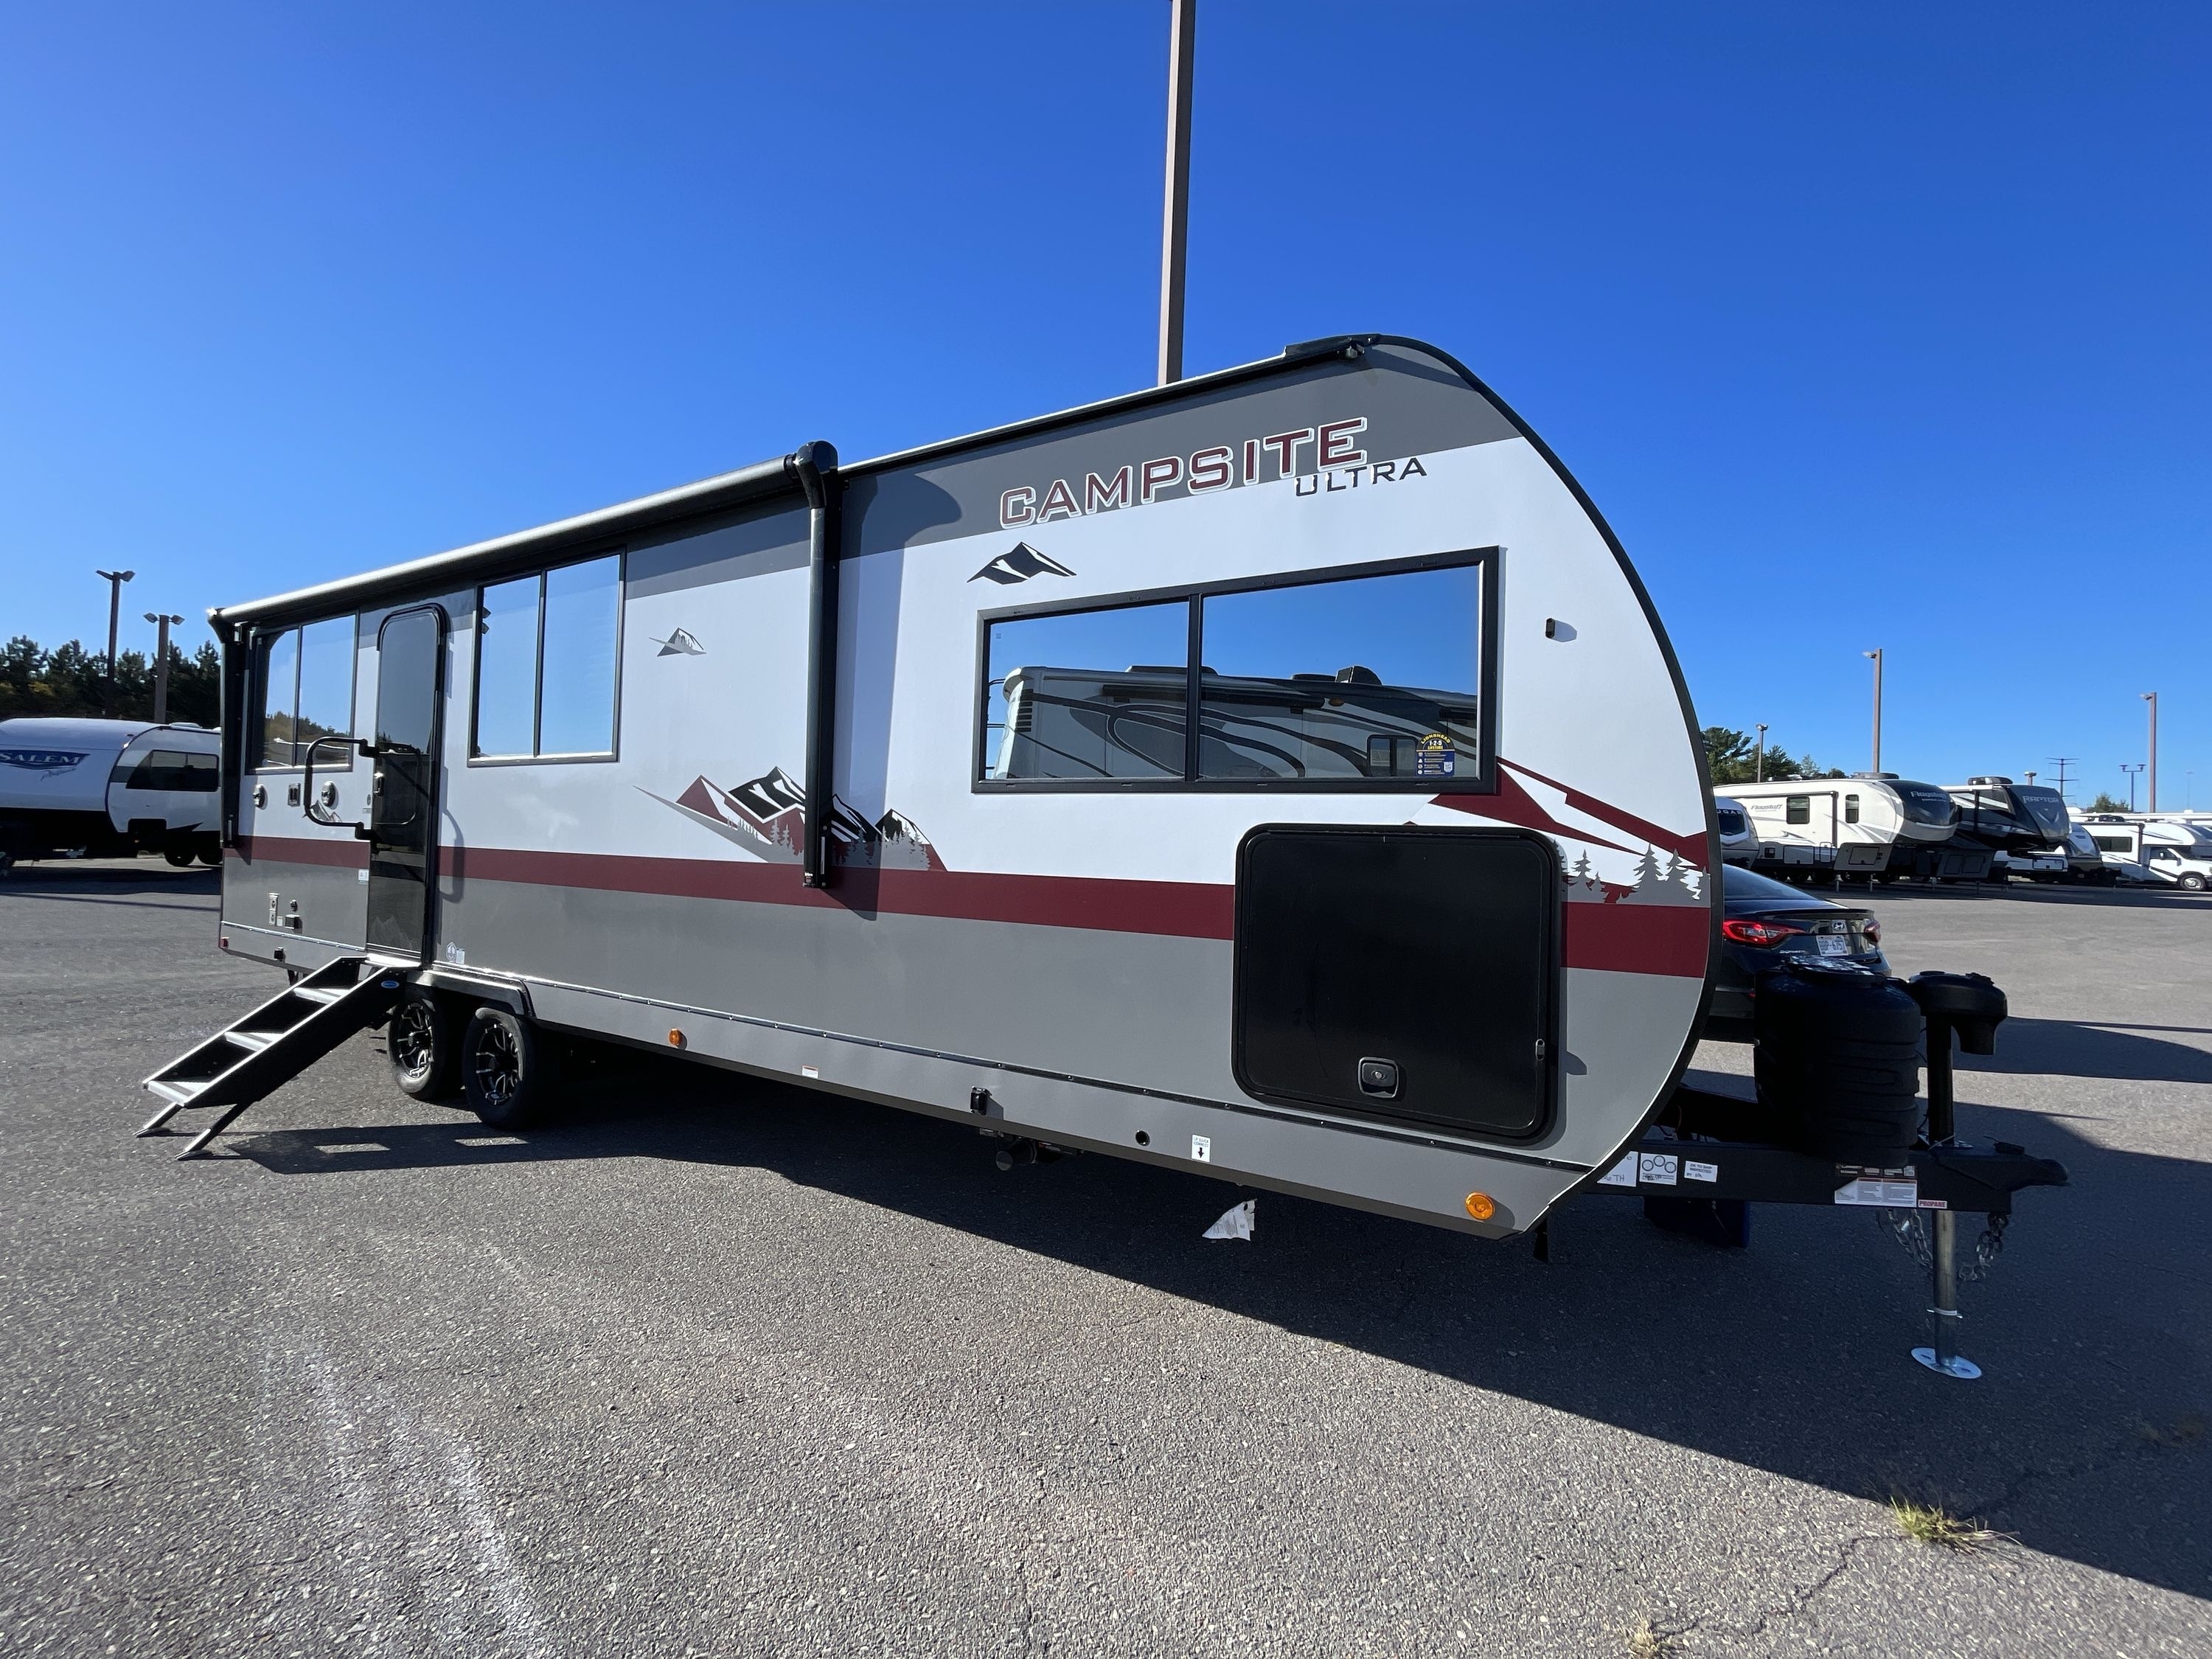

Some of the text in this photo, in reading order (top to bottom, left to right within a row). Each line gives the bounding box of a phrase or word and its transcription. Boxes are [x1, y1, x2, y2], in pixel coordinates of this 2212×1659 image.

[1000, 417, 1368, 529] CAMPSITE
[1295, 457, 1427, 497] ULTRA
[1421, 733, 1451, 744] LIONSHEAD
[0, 752, 80, 764] SALEM
[2023, 796, 2059, 804] RAPTOR
